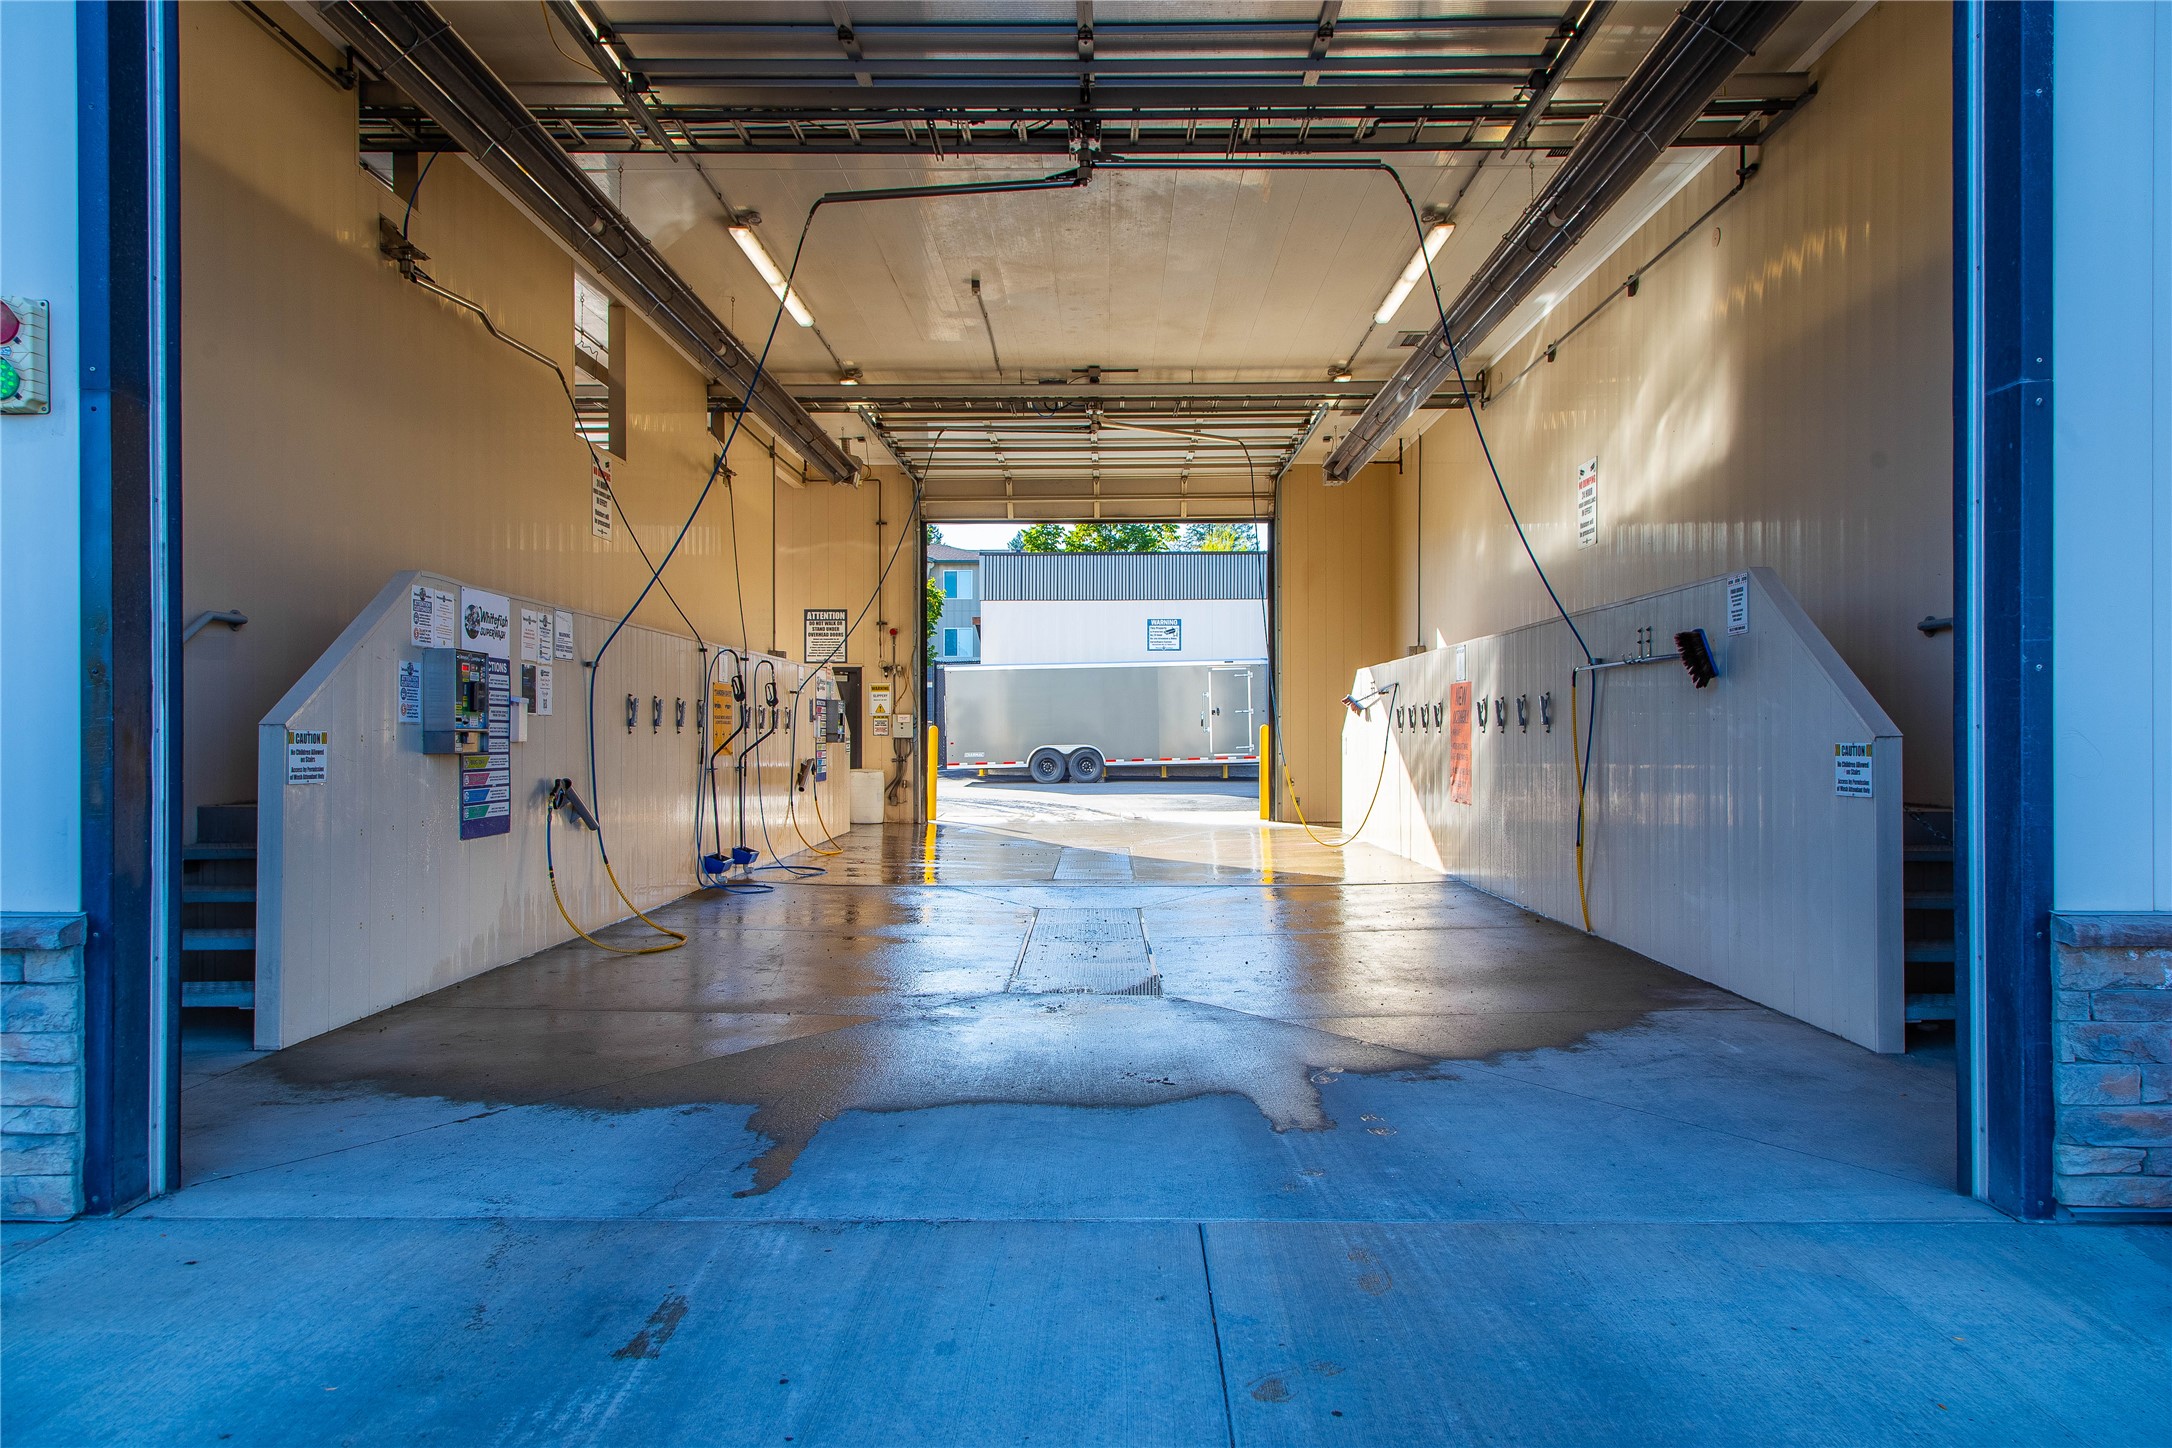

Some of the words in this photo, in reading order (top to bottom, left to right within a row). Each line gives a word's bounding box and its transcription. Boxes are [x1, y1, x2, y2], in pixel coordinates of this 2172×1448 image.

[1583, 474, 1595, 488] DUMPING
[479, 606, 508, 628] Whitefish
[480, 627, 506, 641] SUPERWASH
[1456, 686, 1467, 706] NEW
[296, 733, 320, 744] CAUTION
[1842, 745, 1865, 756] CAUTION
